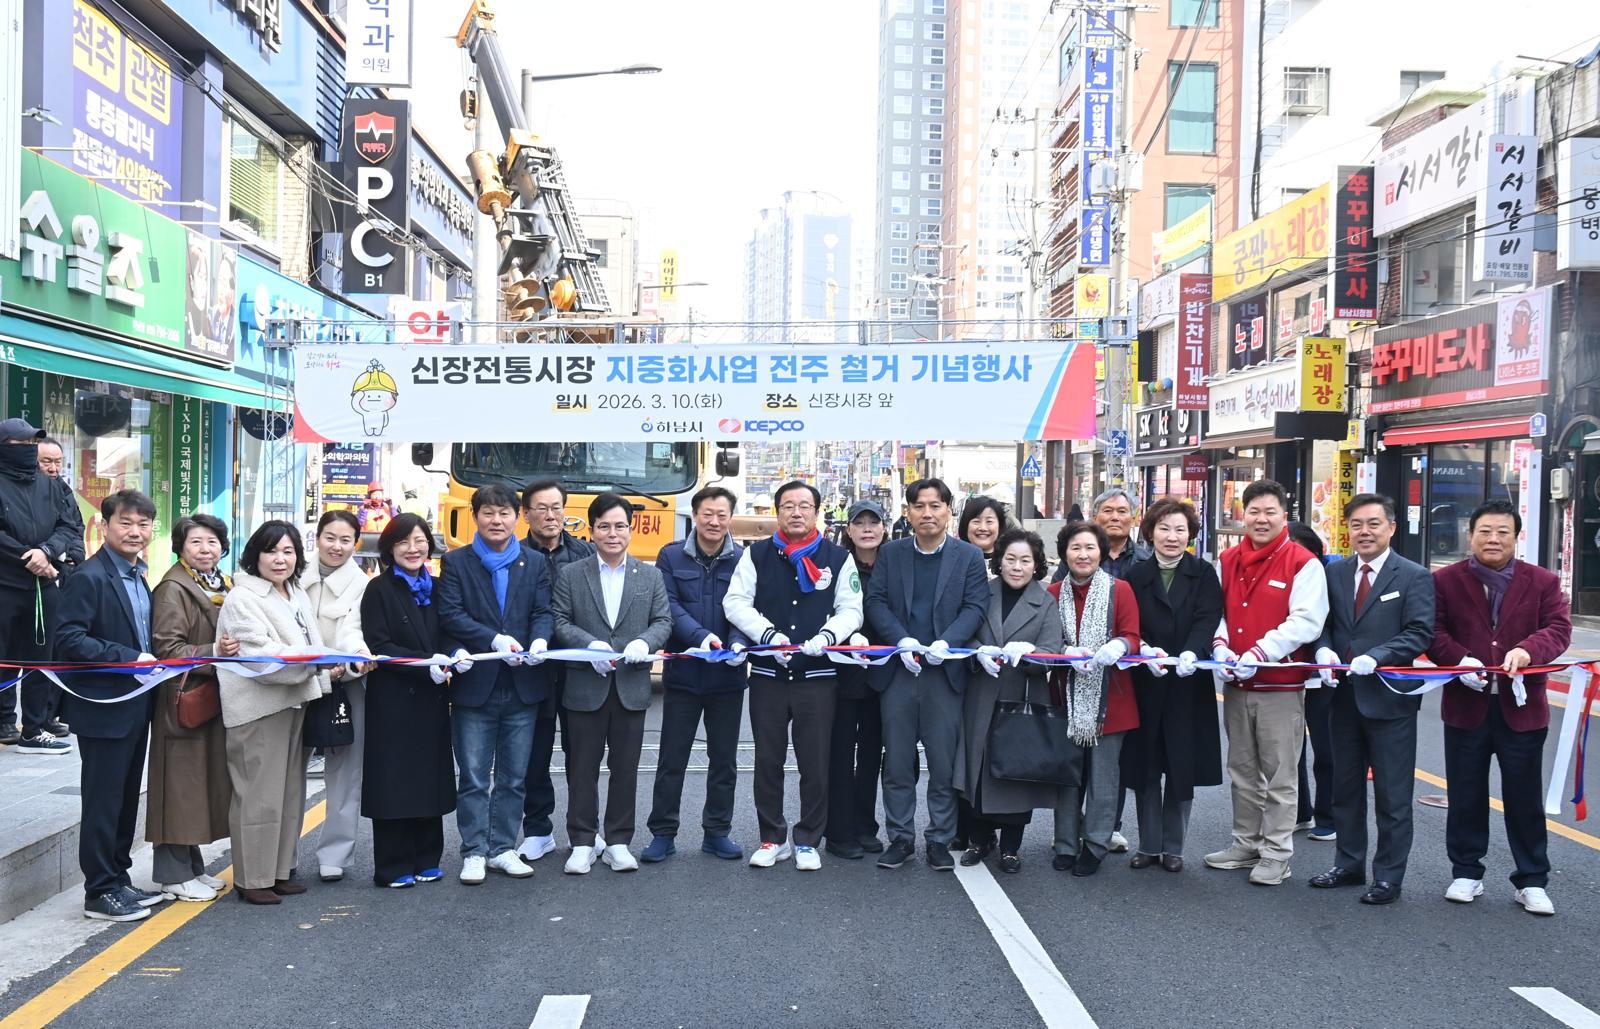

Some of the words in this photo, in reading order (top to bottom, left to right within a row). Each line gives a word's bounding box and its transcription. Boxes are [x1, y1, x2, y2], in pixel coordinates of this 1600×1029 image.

[74, 7, 115, 75] 척추
[131, 46, 166, 114] 관절
[361, 58, 390, 73] 의원
[86, 88, 155, 162] 통증클리닉
[1497, 143, 1526, 257] 서서갈비
[20, 190, 145, 309] 슈올즈
[1346, 174, 1369, 300] 쭈꾸미도사
[365, 278, 383, 291] B1
[1184, 301, 1207, 387] 반찬가게
[1370, 322, 1487, 387] 쭈꾸미도사
[411, 355, 596, 385] 신장전통시장
[606, 355, 757, 385] 지중화사업
[769, 355, 829, 384] 전주
[840, 354, 899, 383] 철거
[912, 354, 1033, 383] 기념행사
[1312, 343, 1333, 405] 노래장
[556, 394, 588, 410] 일시
[598, 394, 646, 410] 2026.
[650, 394, 667, 410] 3.
[671, 393, 724, 411] 10.(화)
[765, 394, 798, 409] 장소
[808, 393, 873, 409] 신장시장
[879, 393, 894, 409] 앞
[656, 420, 704, 434] 하남시
[743, 419, 806, 437] KEPCO
[1139, 413, 1152, 438] SK
[1158, 409, 1169, 437] kt
[1112, 438, 1120, 448] P
